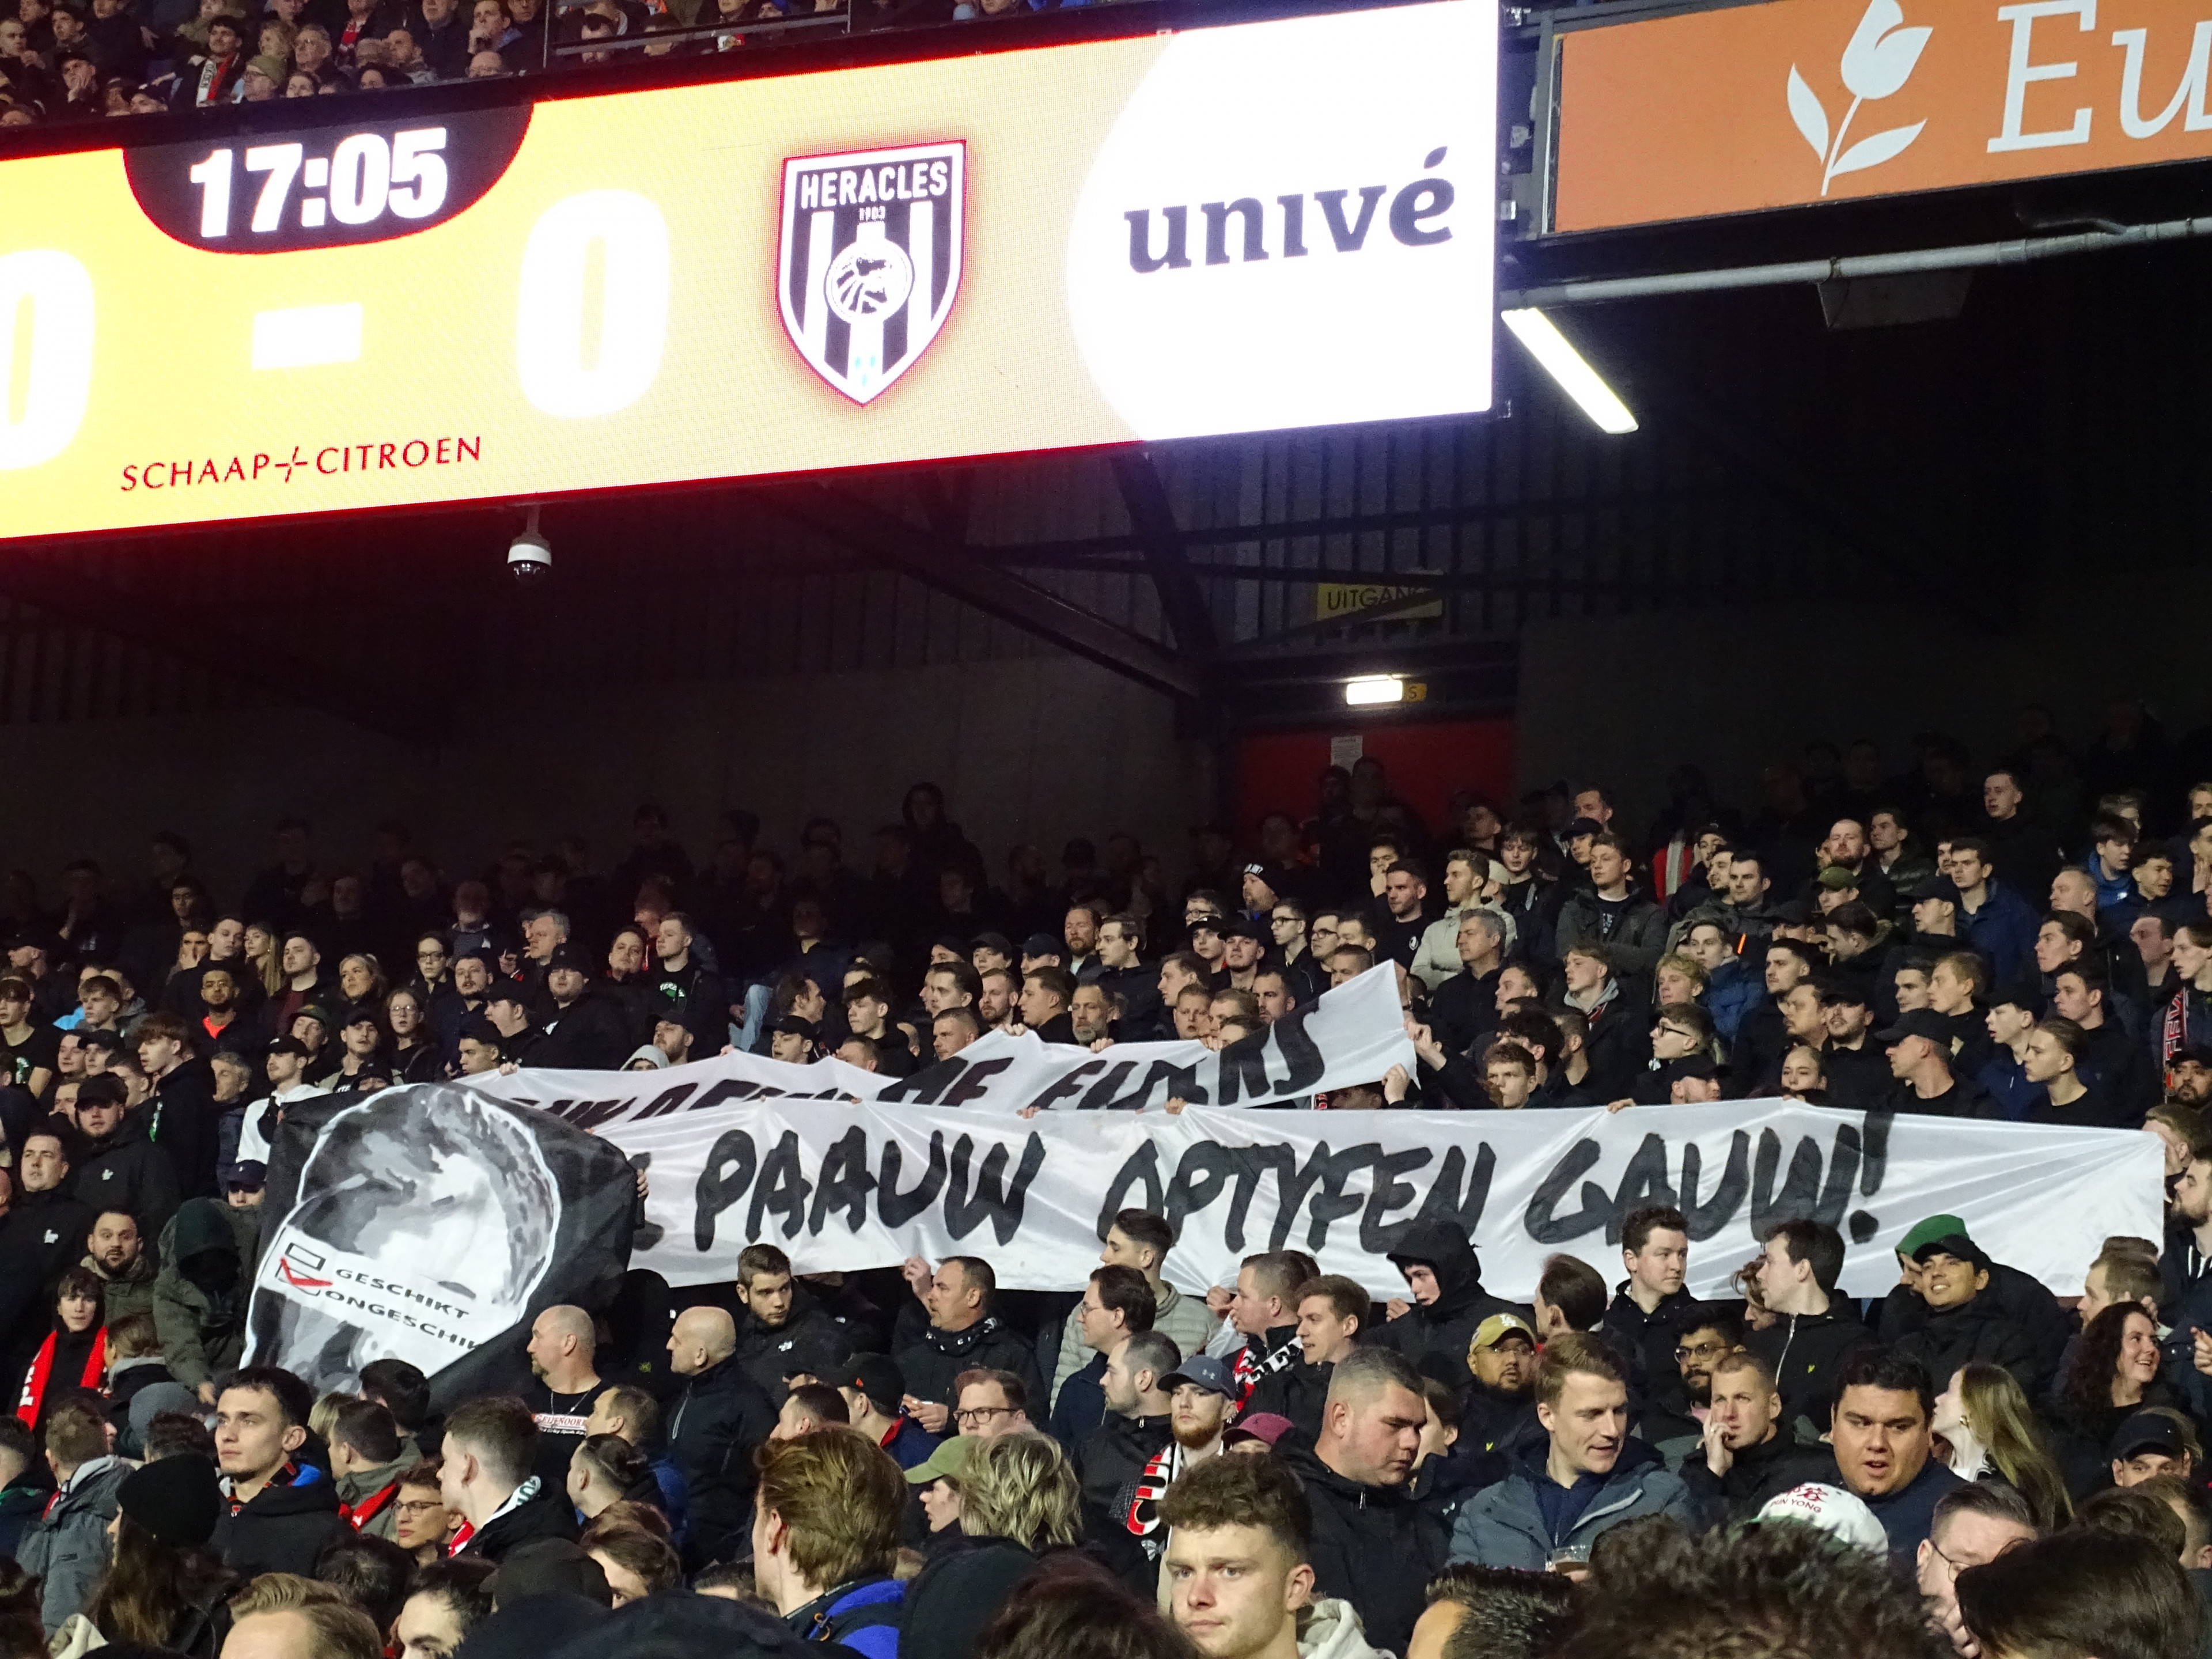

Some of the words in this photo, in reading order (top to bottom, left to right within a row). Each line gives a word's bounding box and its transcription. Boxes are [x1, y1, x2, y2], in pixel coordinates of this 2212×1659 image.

[190, 127, 448, 238] 17:05
[801, 161, 948, 209] HERACLES
[1124, 146, 1455, 274] univé
[517, 188, 670, 419] 0
[1327, 585, 1418, 611] UITGAN
[694, 1124, 1047, 1253] PAAUW
[335, 1268, 470, 1321] GESCHIKT
[1791, 1499, 1821, 1513] YONG
